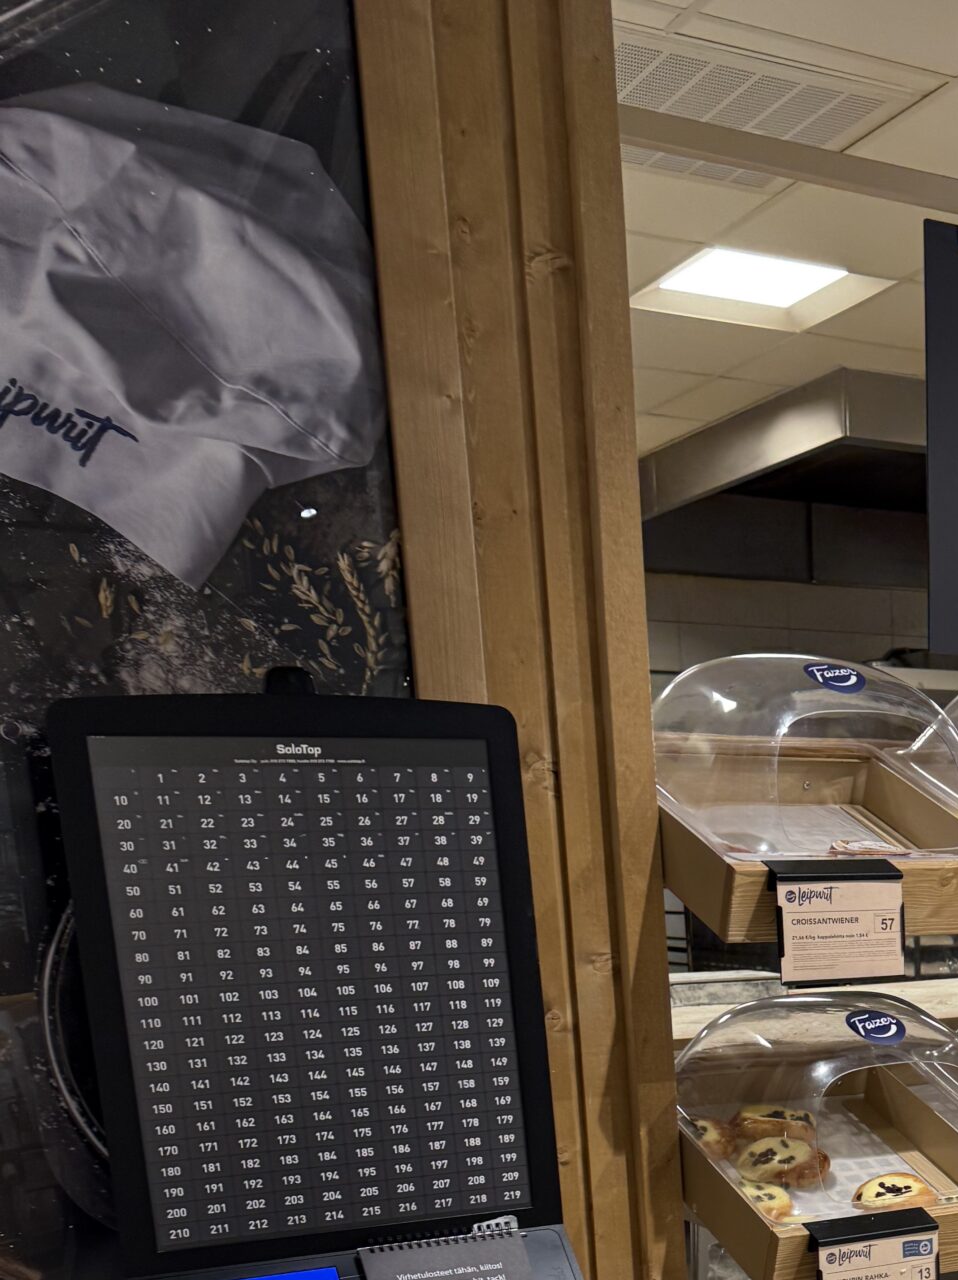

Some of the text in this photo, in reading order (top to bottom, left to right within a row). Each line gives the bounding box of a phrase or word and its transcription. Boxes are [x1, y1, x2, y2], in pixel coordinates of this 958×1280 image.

[808, 664, 857, 687] Fazer
[276, 743, 322, 757] SoloTop
[158, 773, 473, 783] 1 2 3 4 5 6 7 8 9
[114, 794, 478, 805] 10 11 12 13 14 15 16 17 18 19
[798, 886, 839, 906] Leipurit
[791, 917, 859, 926] CROISSANTWIENER
[881, 918, 895, 931] 57
[850, 1014, 897, 1037] Fazer
[838, 1243, 878, 1266] Leipurit
[397, 1262, 503, 1280] Virhetulosteet tähän, kiitos!
[918, 1267, 931, 1280] 13
